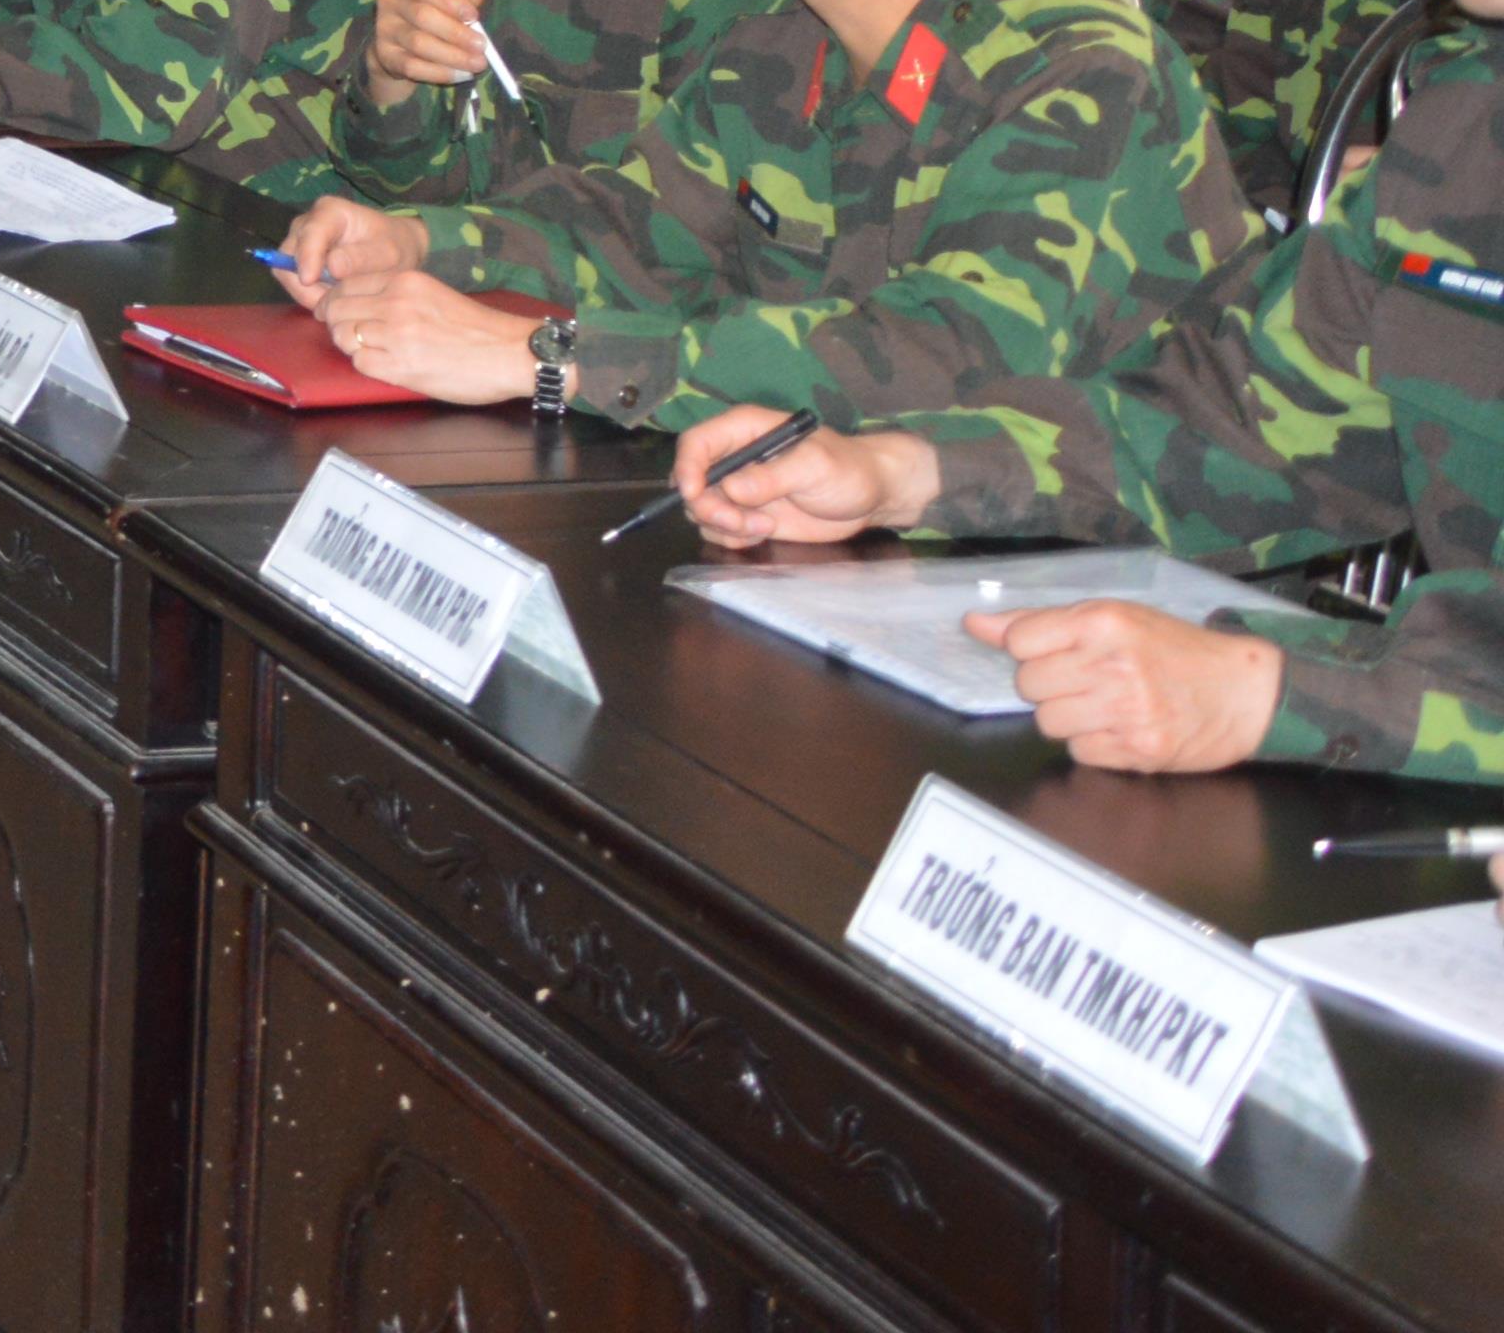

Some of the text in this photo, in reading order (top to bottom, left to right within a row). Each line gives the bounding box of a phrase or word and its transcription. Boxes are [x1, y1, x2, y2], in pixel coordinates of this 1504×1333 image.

[303, 505, 489, 649] TRƯỞNG BAN TMKH/PHC
[898, 847, 1229, 1096] TRƯỞNG BAN TMKH/PKT
